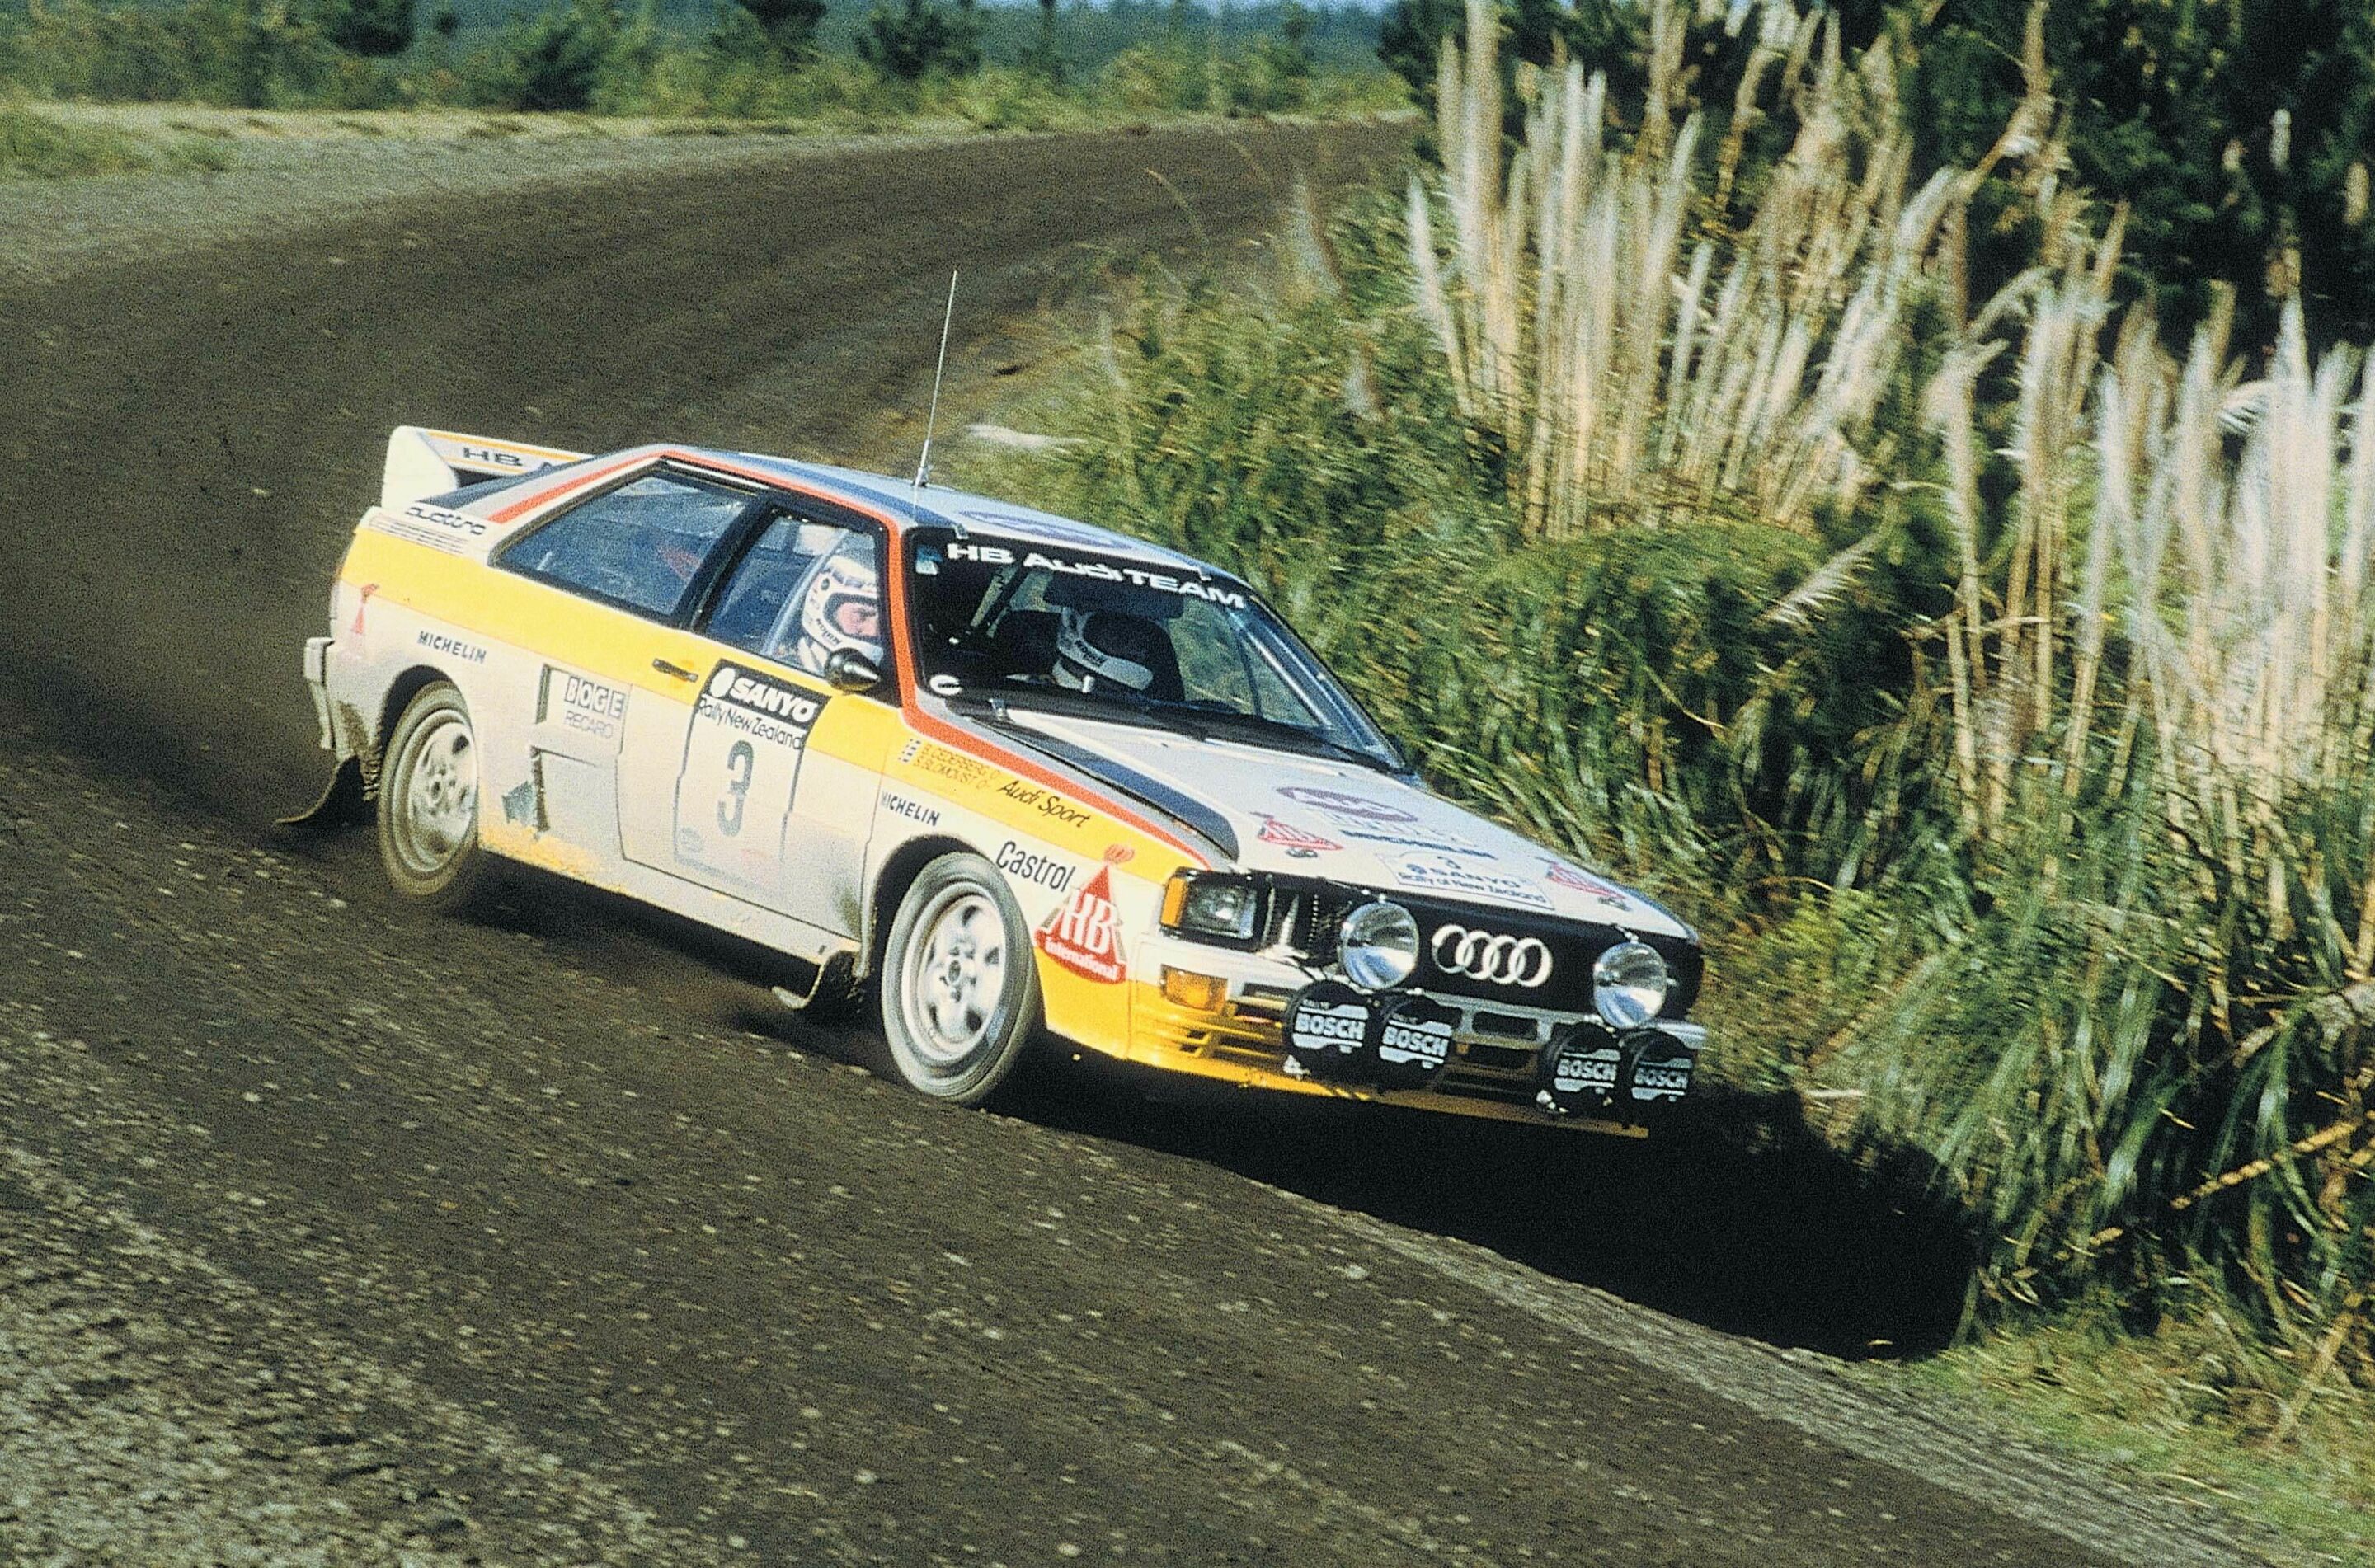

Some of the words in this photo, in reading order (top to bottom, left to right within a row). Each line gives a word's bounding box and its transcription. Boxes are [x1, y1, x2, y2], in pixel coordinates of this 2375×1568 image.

[463, 447, 524, 467] HB
[404, 506, 487, 536] quattro
[947, 542, 1014, 565] HB
[1122, 568, 1244, 609] TEAM
[416, 630, 487, 663] MICHELIN
[564, 675, 627, 720] BOGE
[729, 677, 819, 723] SANYO
[564, 710, 614, 739] RECARO
[726, 707, 753, 732] New
[751, 716, 805, 751] Zealand
[717, 739, 755, 838] 3
[996, 780, 1045, 805] Audi
[1037, 795, 1091, 828] Sport
[882, 791, 941, 827] MICHELIN
[995, 840, 1076, 893] Castrol
[1429, 867, 1521, 889] SANYO
[1059, 888, 1119, 955] HB
[1294, 1012, 1366, 1041] BOSCH
[1381, 1025, 1451, 1058] BOSCH
[1556, 1058, 1618, 1082] BOSCH
[1633, 1068, 1689, 1090] BOSCH
